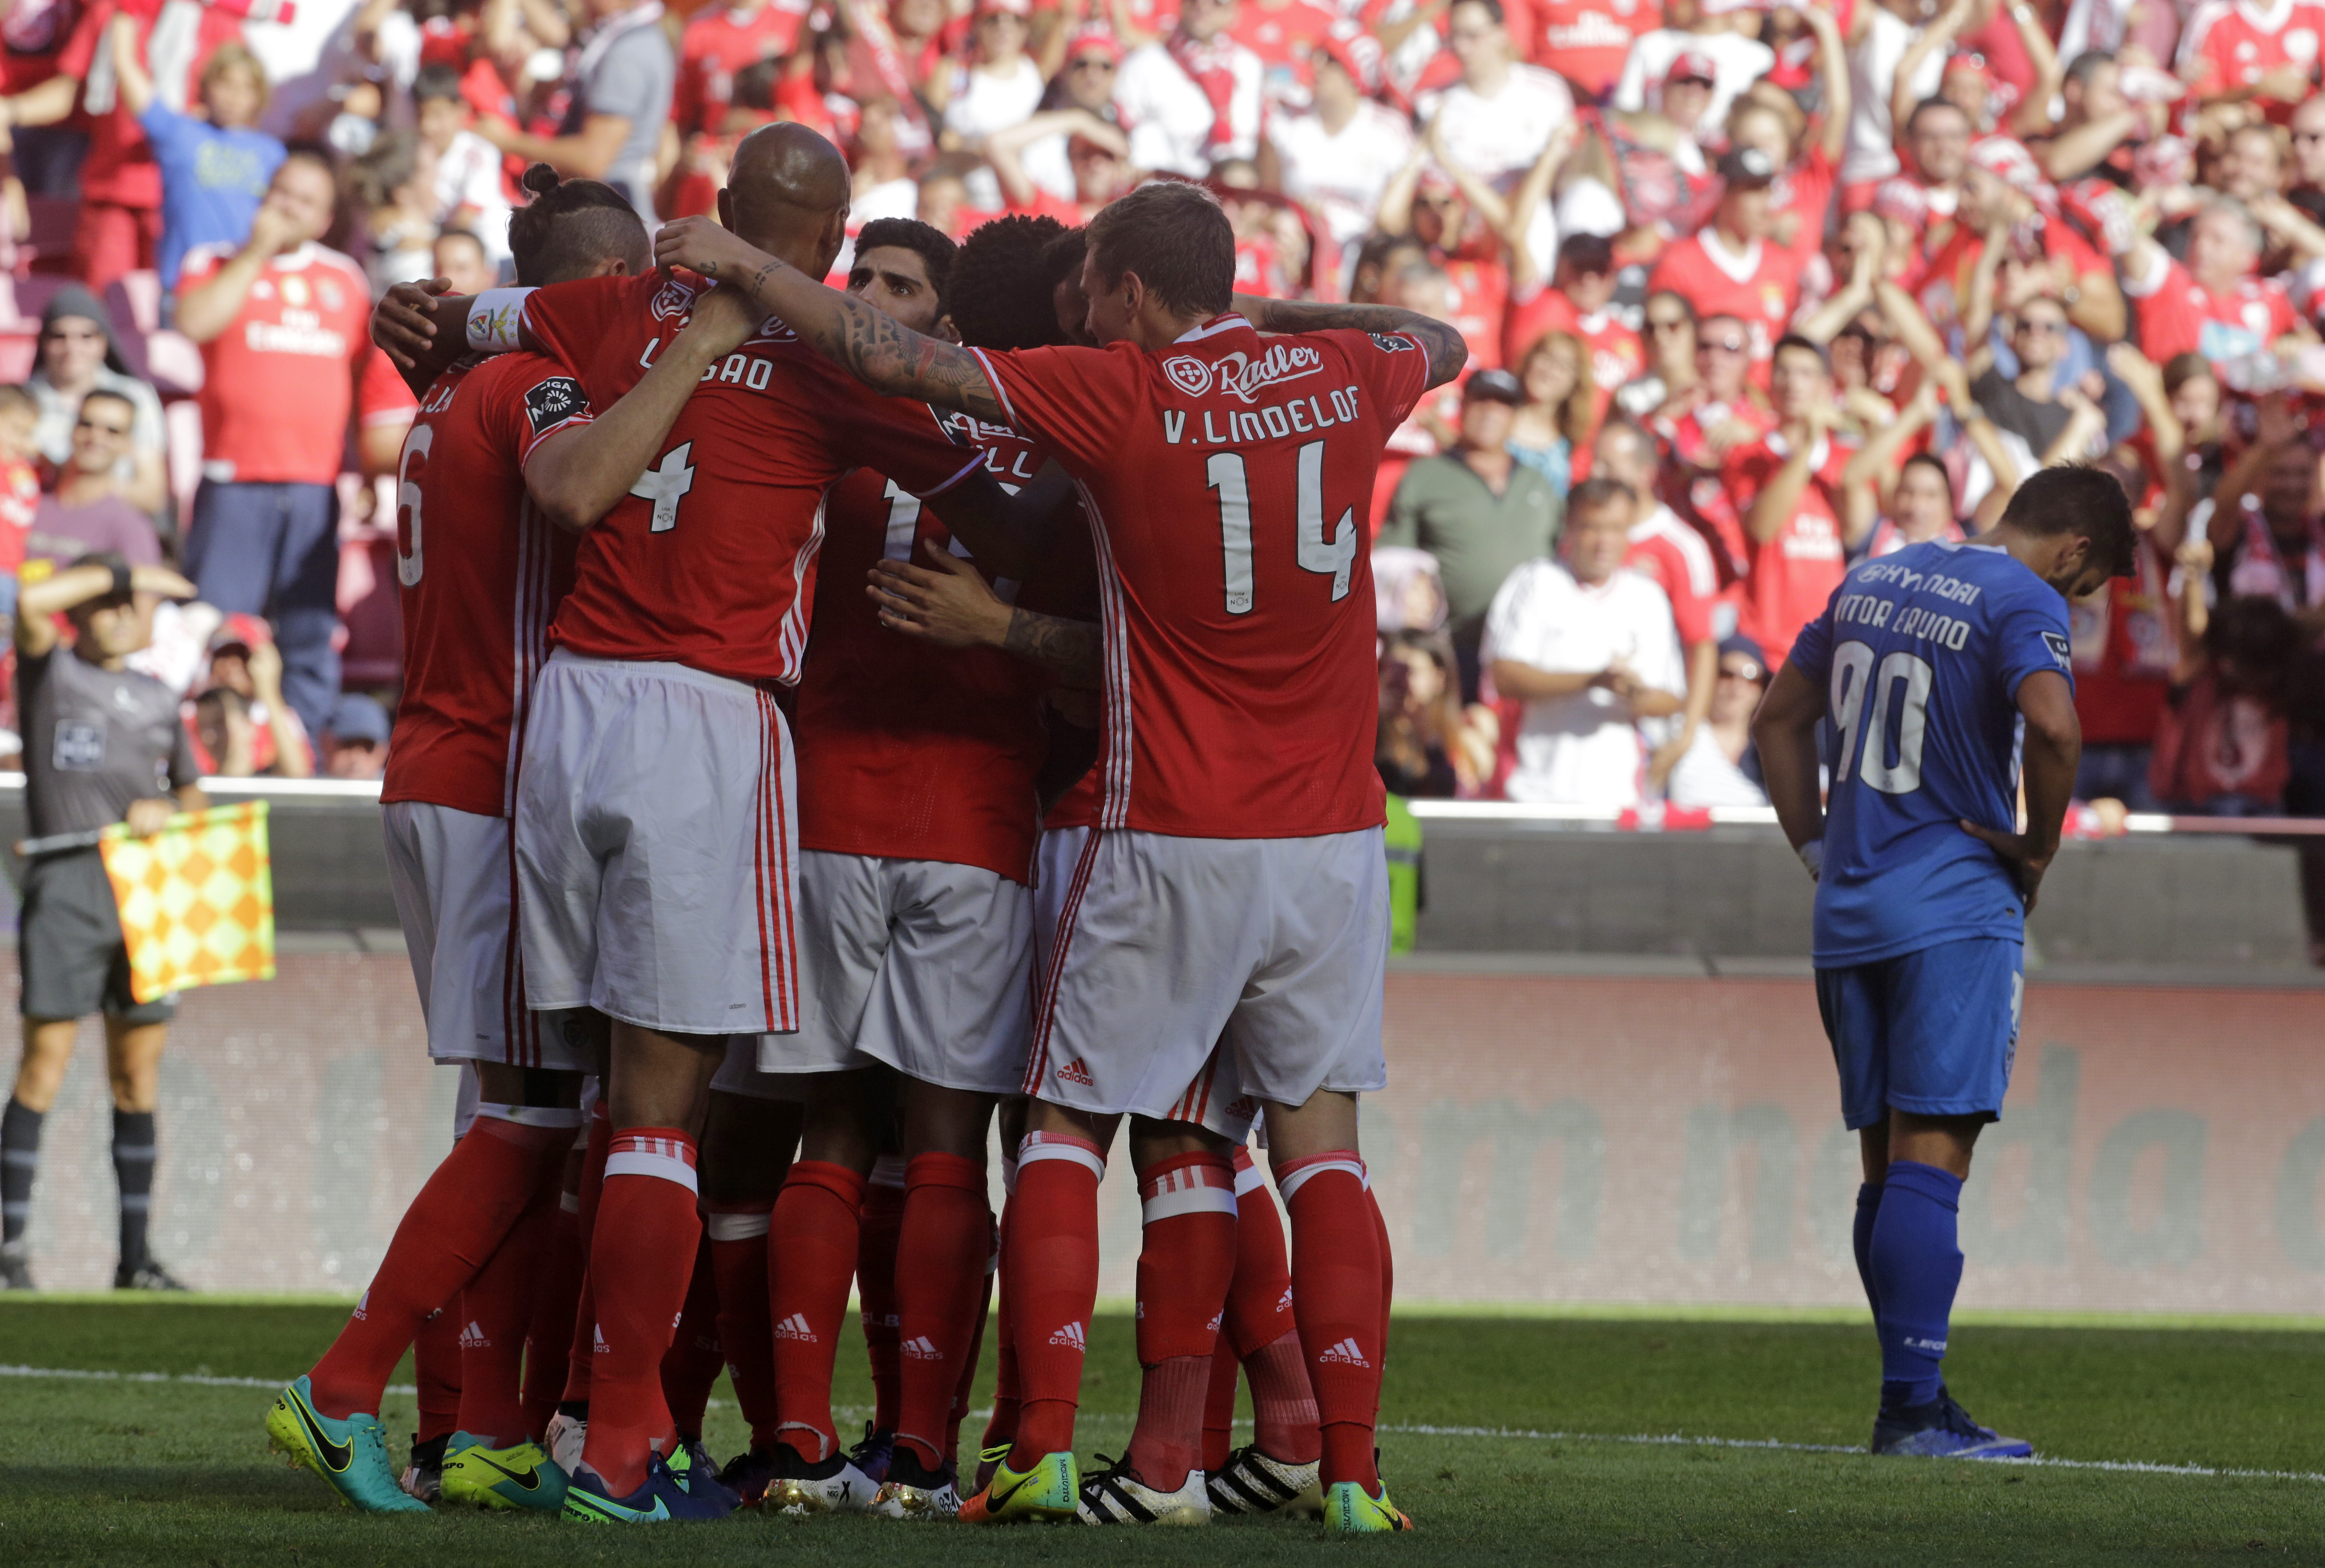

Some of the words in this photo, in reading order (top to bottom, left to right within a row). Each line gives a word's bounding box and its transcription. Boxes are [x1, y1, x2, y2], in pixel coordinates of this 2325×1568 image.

[639, 337, 773, 390] LSAO
[1211, 344, 1324, 404] Radler
[627, 439, 697, 534] 4
[1205, 438, 1358, 615] 14
[1831, 640, 1933, 794] 90
[1057, 1069, 1094, 1087] adidas
[1225, 1106, 1255, 1123] adida
[775, 1330, 817, 1343] adidas
[1319, 1354, 1370, 1368] adidas
